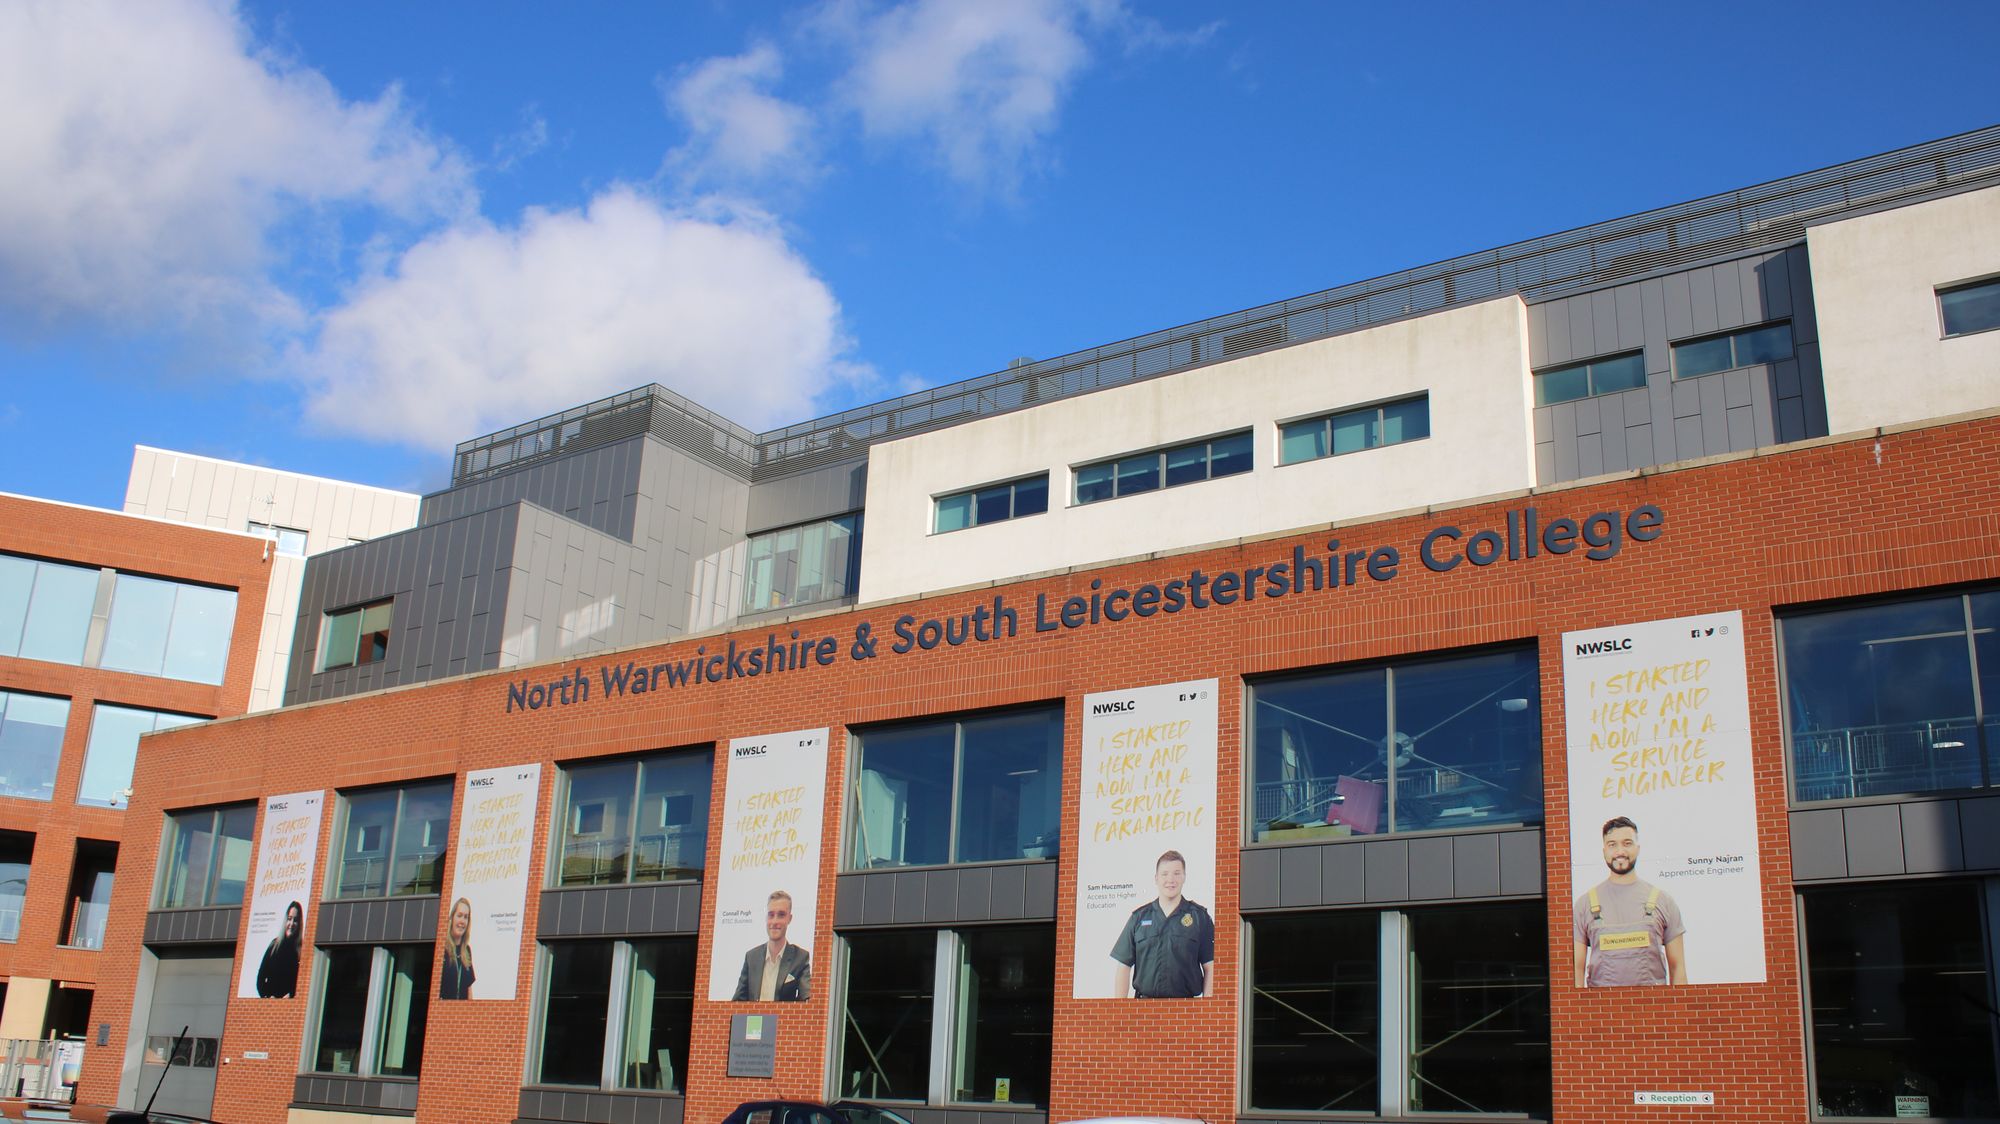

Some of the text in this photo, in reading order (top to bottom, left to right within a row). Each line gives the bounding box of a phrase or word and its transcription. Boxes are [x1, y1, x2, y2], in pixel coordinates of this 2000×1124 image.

[506, 504, 1665, 713] North Warwickshire & South Leicestershire College
[1576, 638, 1632, 655] NWSLC
[1589, 658, 1711, 699] I STARTED
[1093, 700, 1135, 715] NWSLC
[1658, 687, 1710, 719] AND
[1099, 720, 1191, 752] I STARTED
[1589, 713, 1716, 753] NOW I'M A
[735, 745, 767, 757] NWSLC
[1150, 744, 1189, 769] AND
[470, 777, 494, 787] NWSLC
[1096, 767, 1192, 799] NOW I'M A
[269, 802, 288, 810] NWSLC
[747, 785, 805, 810] STARTED
[773, 808, 802, 827] AND
[1093, 806, 1204, 843] PARAMEDIC
[743, 828, 798, 851] WENT TO
[731, 843, 808, 872] UNIVERSITY
[1688, 854, 1744, 865] Sunny Najran
[1659, 866, 1744, 878] Apprentice Engineer
[1650, 1094, 1697, 1103] Reception
